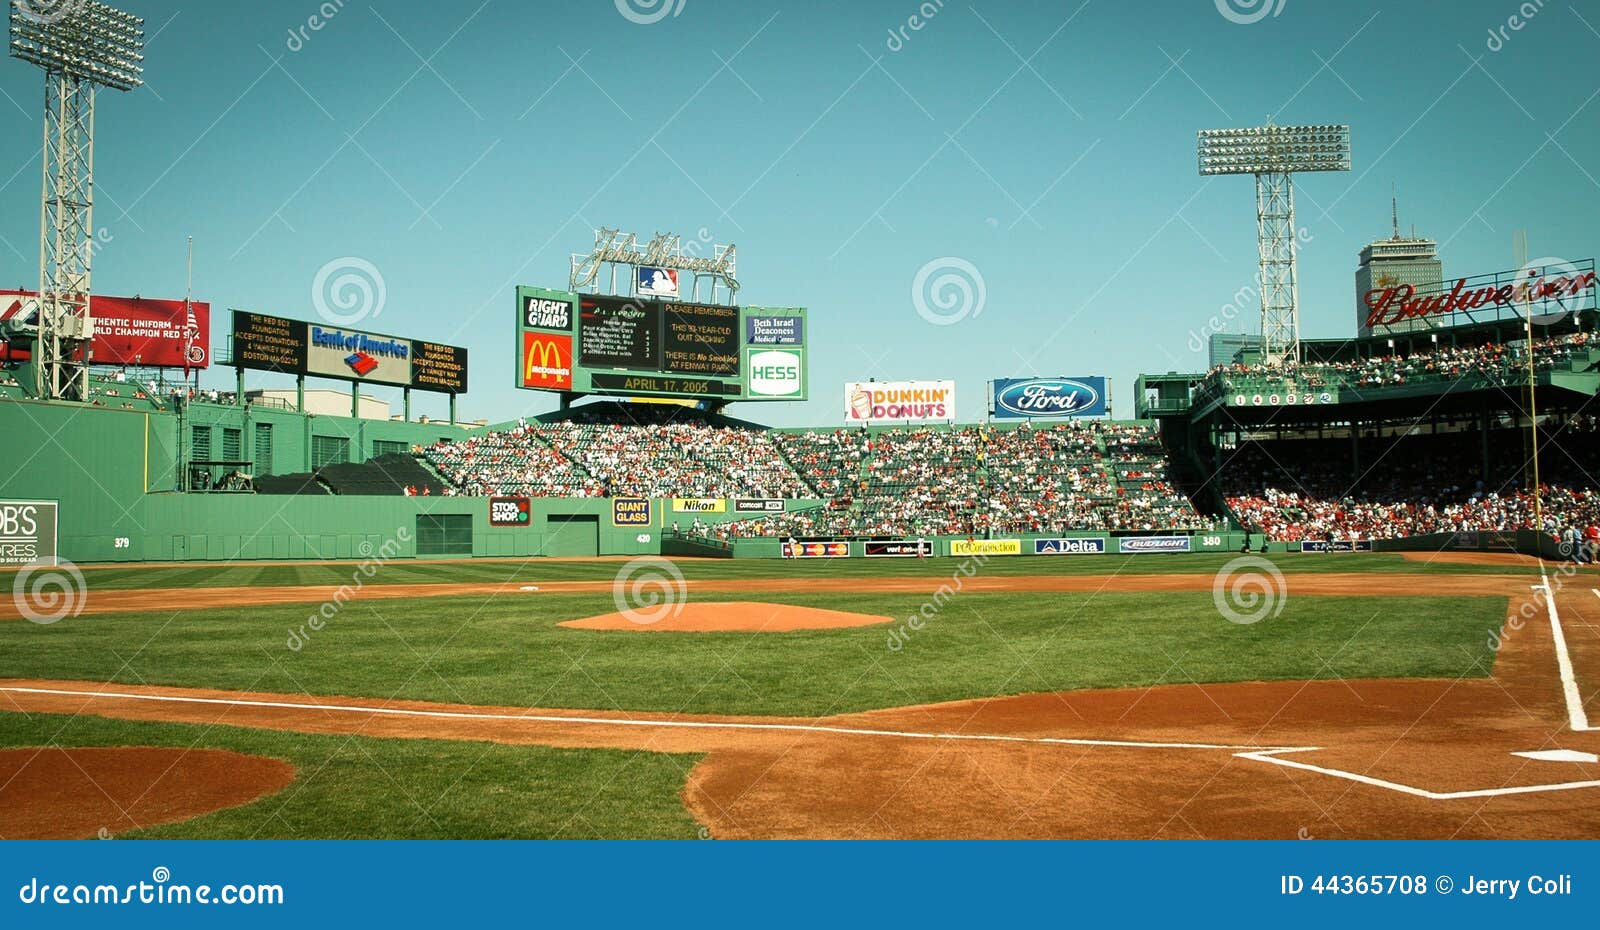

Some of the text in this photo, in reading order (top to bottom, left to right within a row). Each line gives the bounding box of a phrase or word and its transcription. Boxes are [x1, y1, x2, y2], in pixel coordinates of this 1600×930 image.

[571, 226, 642, 287] John
[637, 230, 740, 292] Hancock
[1364, 269, 1597, 328] Budweiser
[665, 303, 693, 315] PLEASE
[94, 318, 129, 327] THENTIC
[133, 320, 171, 329] UNIFORM
[528, 312, 568, 328] GUARD
[753, 318, 794, 327] Beth Israel
[671, 323, 687, 332] THIS
[754, 326, 794, 335] Deaconess
[115, 329, 160, 338] CHAMPION
[163, 331, 180, 339] RED
[183, 331, 200, 340] SX
[677, 333, 726, 344] QUIT SMOKING
[311, 326, 409, 358] Bank of America
[665, 351, 738, 365] THERE IS No Smoking
[670, 361, 730, 372] AT FENWAY PARK
[752, 366, 797, 379] HESS
[624, 378, 659, 391] APRIL
[683, 381, 709, 393] 2005
[873, 389, 949, 404] DUNKIN'
[1017, 385, 1078, 410] Ford
[1271, 395, 1277, 404] 8
[1288, 395, 1294, 404] 9
[874, 403, 946, 418] DONUTS
[616, 502, 648, 512] GIANT
[683, 500, 716, 511] Nikon
[0, 506, 37, 535] B'S
[616, 512, 648, 522] GLASS
[114, 537, 130, 548] 379
[636, 534, 650, 544] 420
[1153, 539, 1187, 547] LIGHT
[1202, 536, 1221, 546] 380
[1059, 539, 1098, 552] Delta
